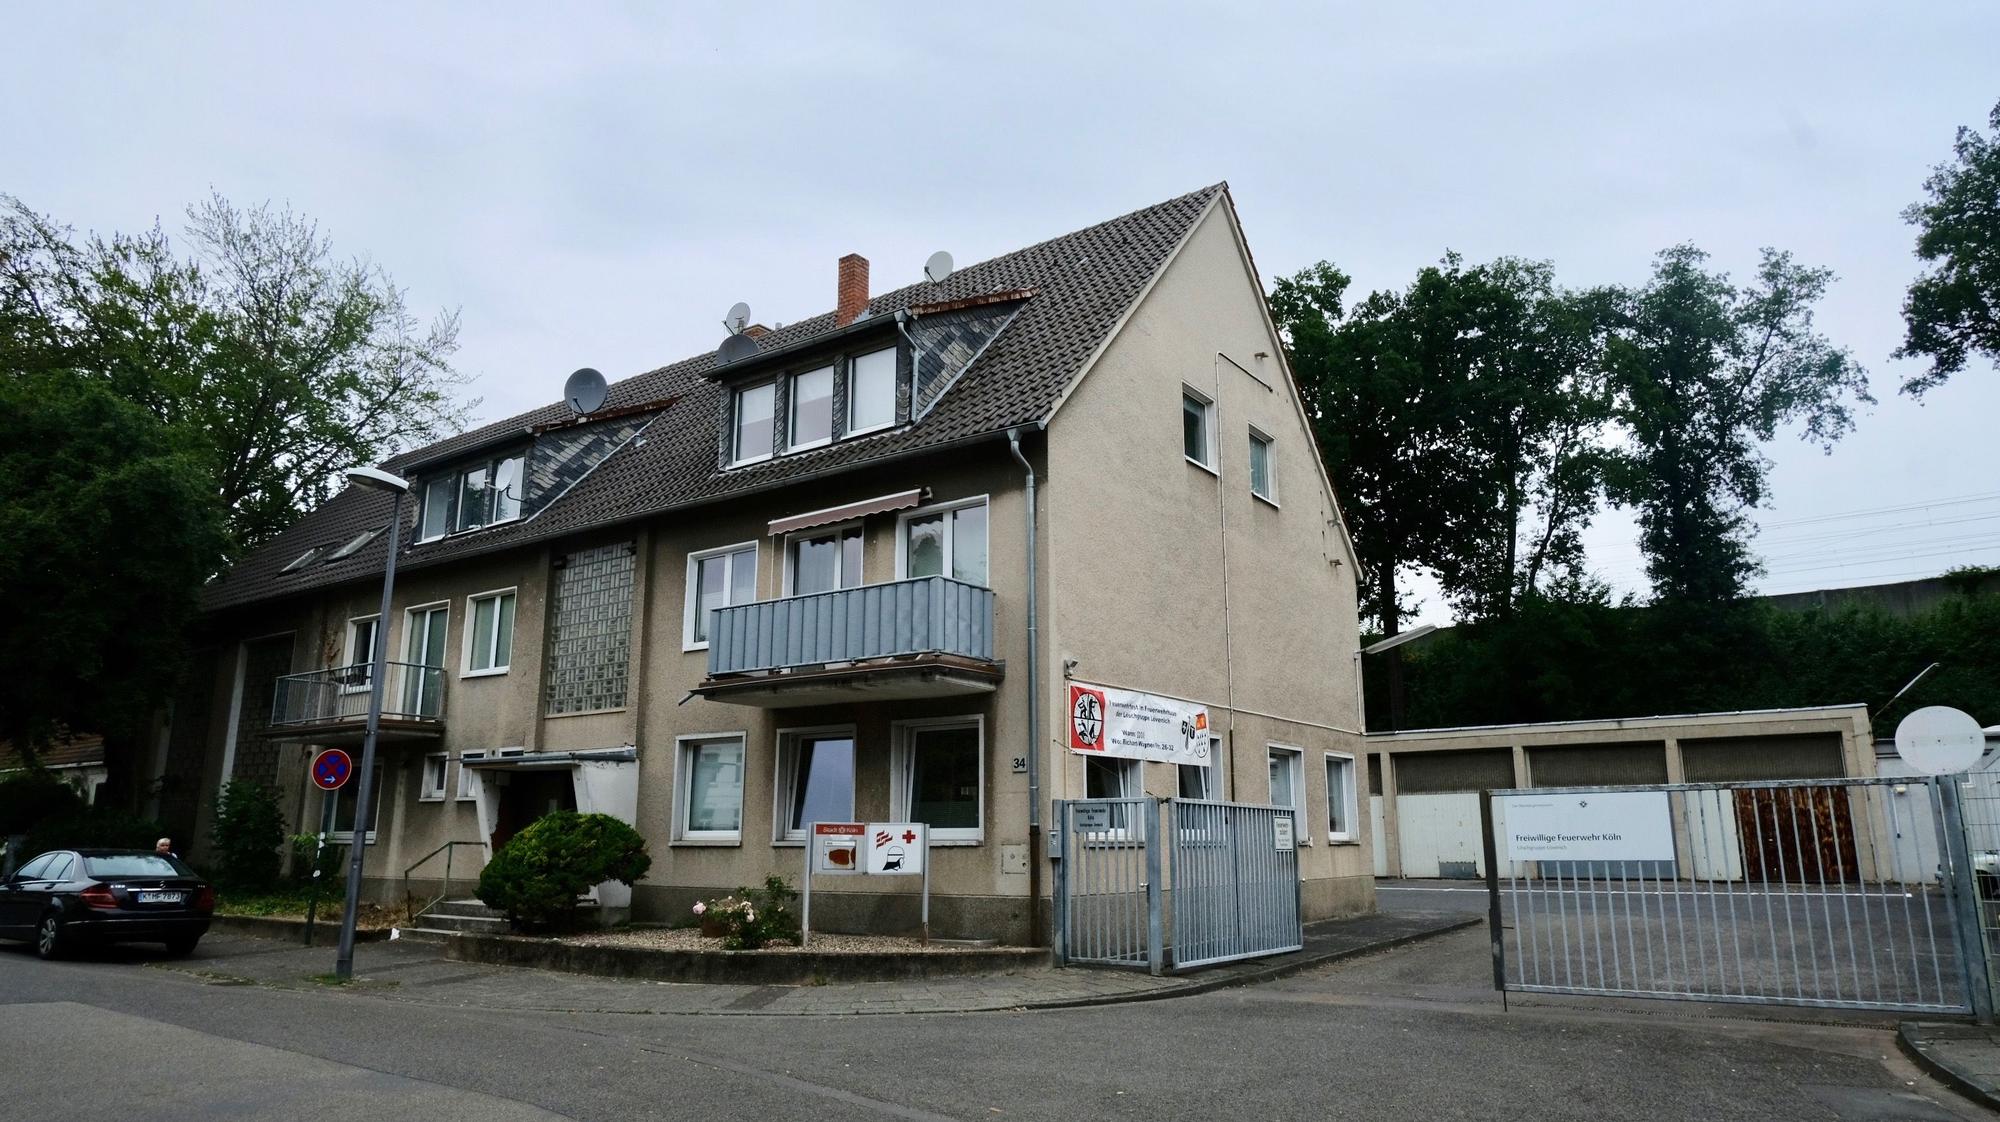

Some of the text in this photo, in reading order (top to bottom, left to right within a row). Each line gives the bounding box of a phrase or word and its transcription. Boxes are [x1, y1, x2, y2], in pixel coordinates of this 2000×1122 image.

[1014, 757, 1025, 768] 34
[1515, 833, 1622, 843] Freiwillige Feuerwehr Köln
